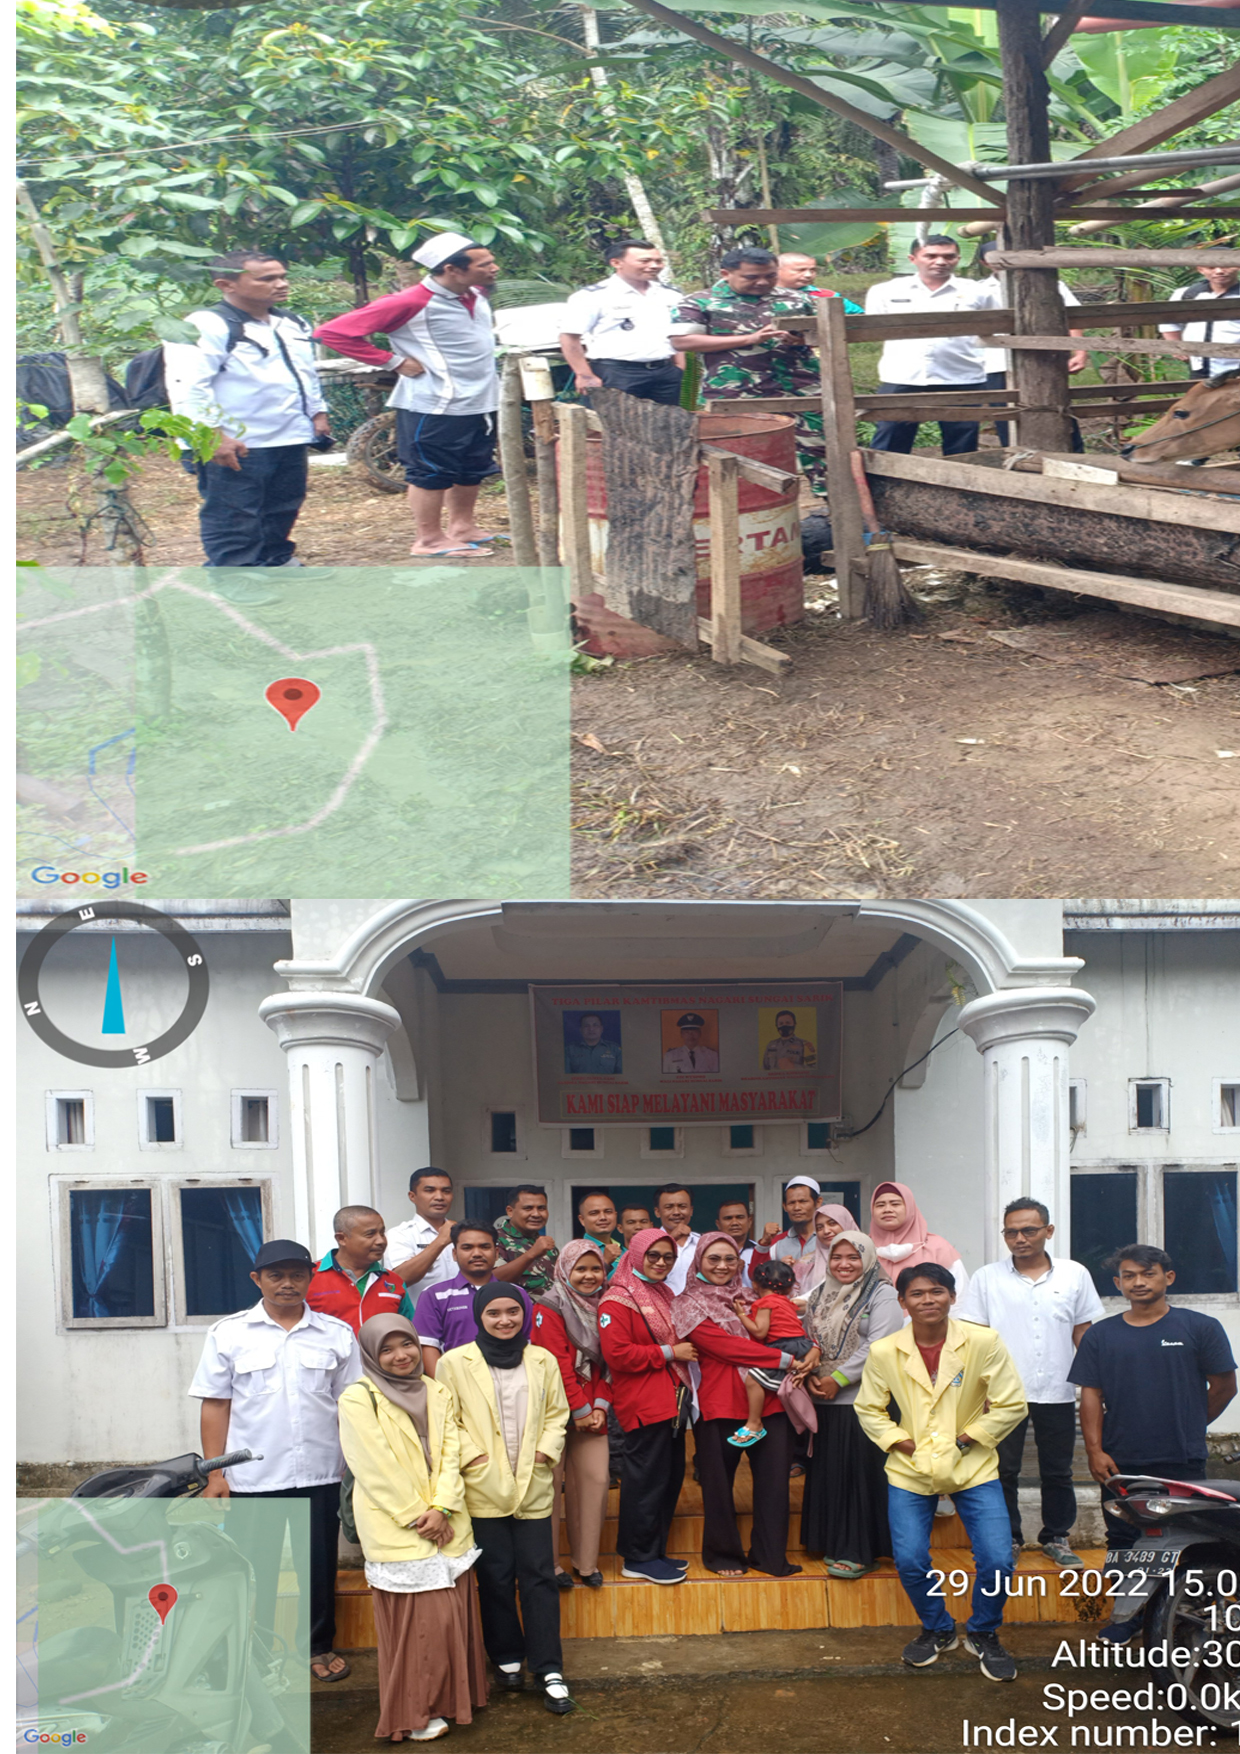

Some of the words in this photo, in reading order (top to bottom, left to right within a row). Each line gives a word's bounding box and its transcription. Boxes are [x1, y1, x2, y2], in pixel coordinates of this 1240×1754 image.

[552, 997, 581, 1006] TIGA
[584, 996, 621, 1006] PILAR
[623, 996, 696, 1006] KAMTIBMAS
[699, 995, 746, 1005] NAGARI
[748, 995, 794, 1004] SUNGAI
[566, 1093, 605, 1114] KAMI
[607, 1093, 641, 1114] SIAP
[643, 1092, 716, 1114] MELAYANI
[718, 1089, 817, 1112] MASYARAKAT
[1105, 1551, 1119, 1563] BA
[1124, 1550, 1156, 1563] 3489
[1161, 1550, 1179, 1563] GT
